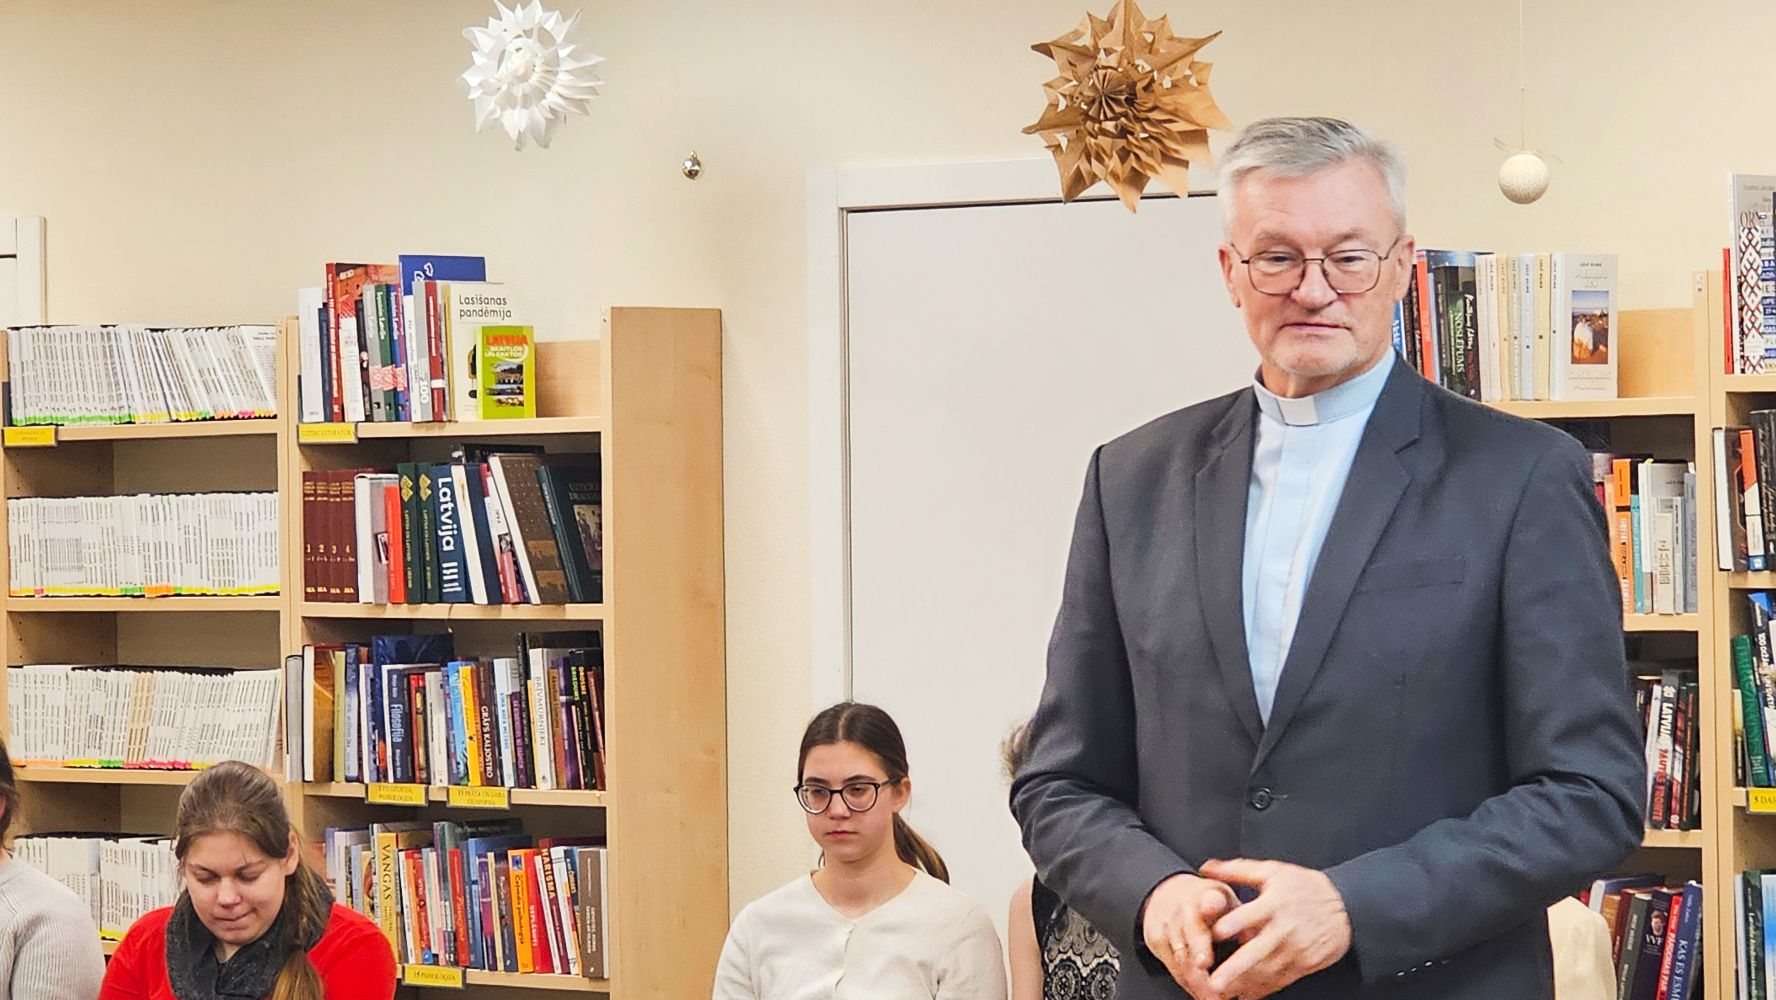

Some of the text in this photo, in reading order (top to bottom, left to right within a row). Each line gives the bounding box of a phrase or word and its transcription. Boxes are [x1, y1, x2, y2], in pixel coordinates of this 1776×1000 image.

[459, 294, 507, 305] Lasīšanas
[460, 306, 512, 319] pandēmija
[484, 335, 529, 346] LATVIJA
[1454, 312, 1465, 373] NOSLĒPUMS
[420, 379, 429, 404] 100
[437, 477, 457, 551] Latvija
[578, 667, 587, 695] DROSME
[390, 703, 404, 743] Filosofija
[481, 706, 491, 733] GRĀFS
[535, 676, 546, 746] BRĪVMŪRNIEKI
[381, 844, 393, 901] VANGAS
[541, 848, 556, 899] HARISMA
[1677, 939, 1689, 961] KAS
[1675, 962, 1686, 976] ES
